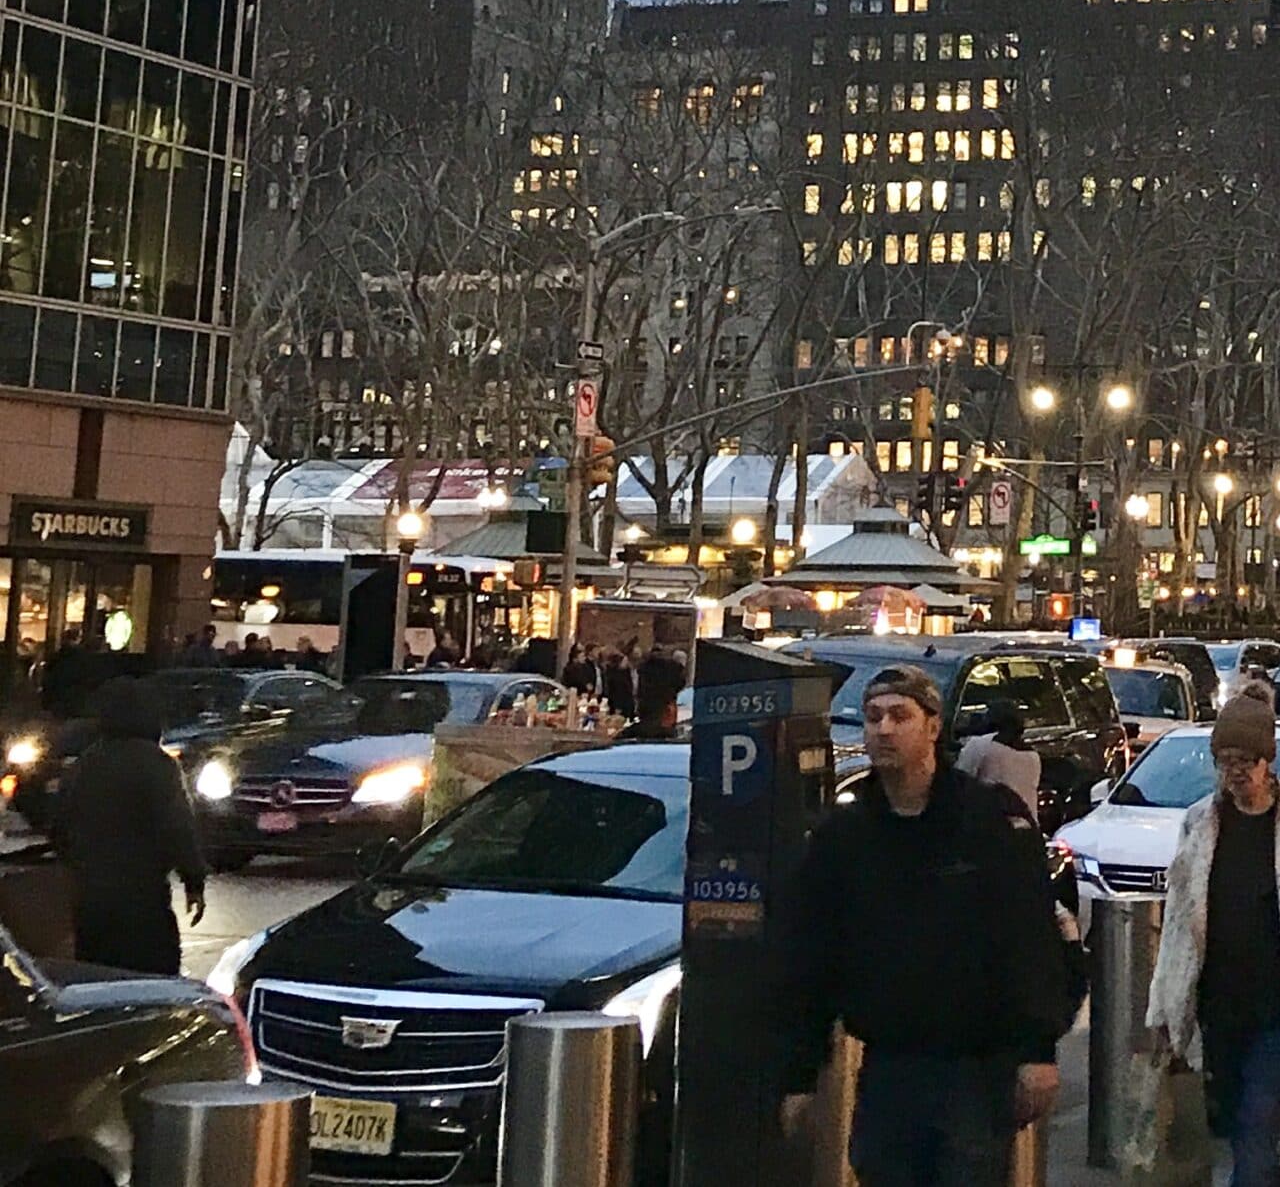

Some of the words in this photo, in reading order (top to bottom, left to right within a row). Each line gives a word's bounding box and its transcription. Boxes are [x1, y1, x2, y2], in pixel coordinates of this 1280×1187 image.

[31, 512, 130, 541] STARBUCKS
[722, 734, 758, 795] P
[693, 881, 761, 900] 103956
